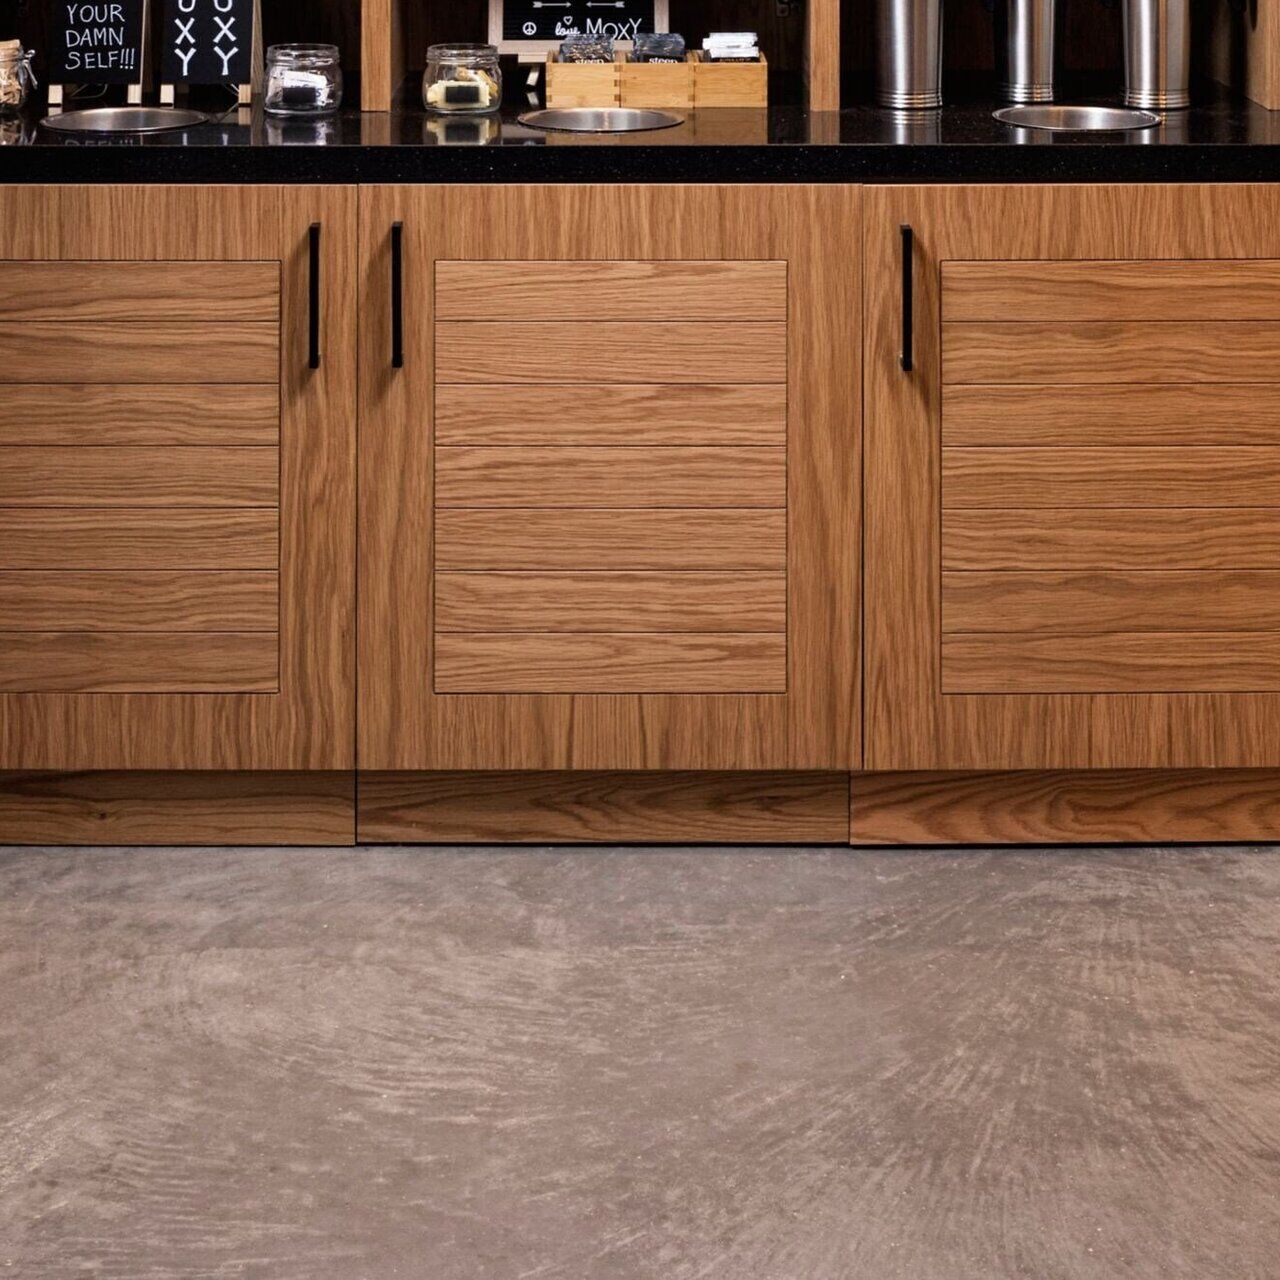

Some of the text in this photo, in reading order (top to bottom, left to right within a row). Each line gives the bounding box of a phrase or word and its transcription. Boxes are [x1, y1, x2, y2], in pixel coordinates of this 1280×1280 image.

[66, 3, 125, 24] YOUR
[65, 26, 124, 48] DAMN
[64, 47, 135, 71] SELF!!!
